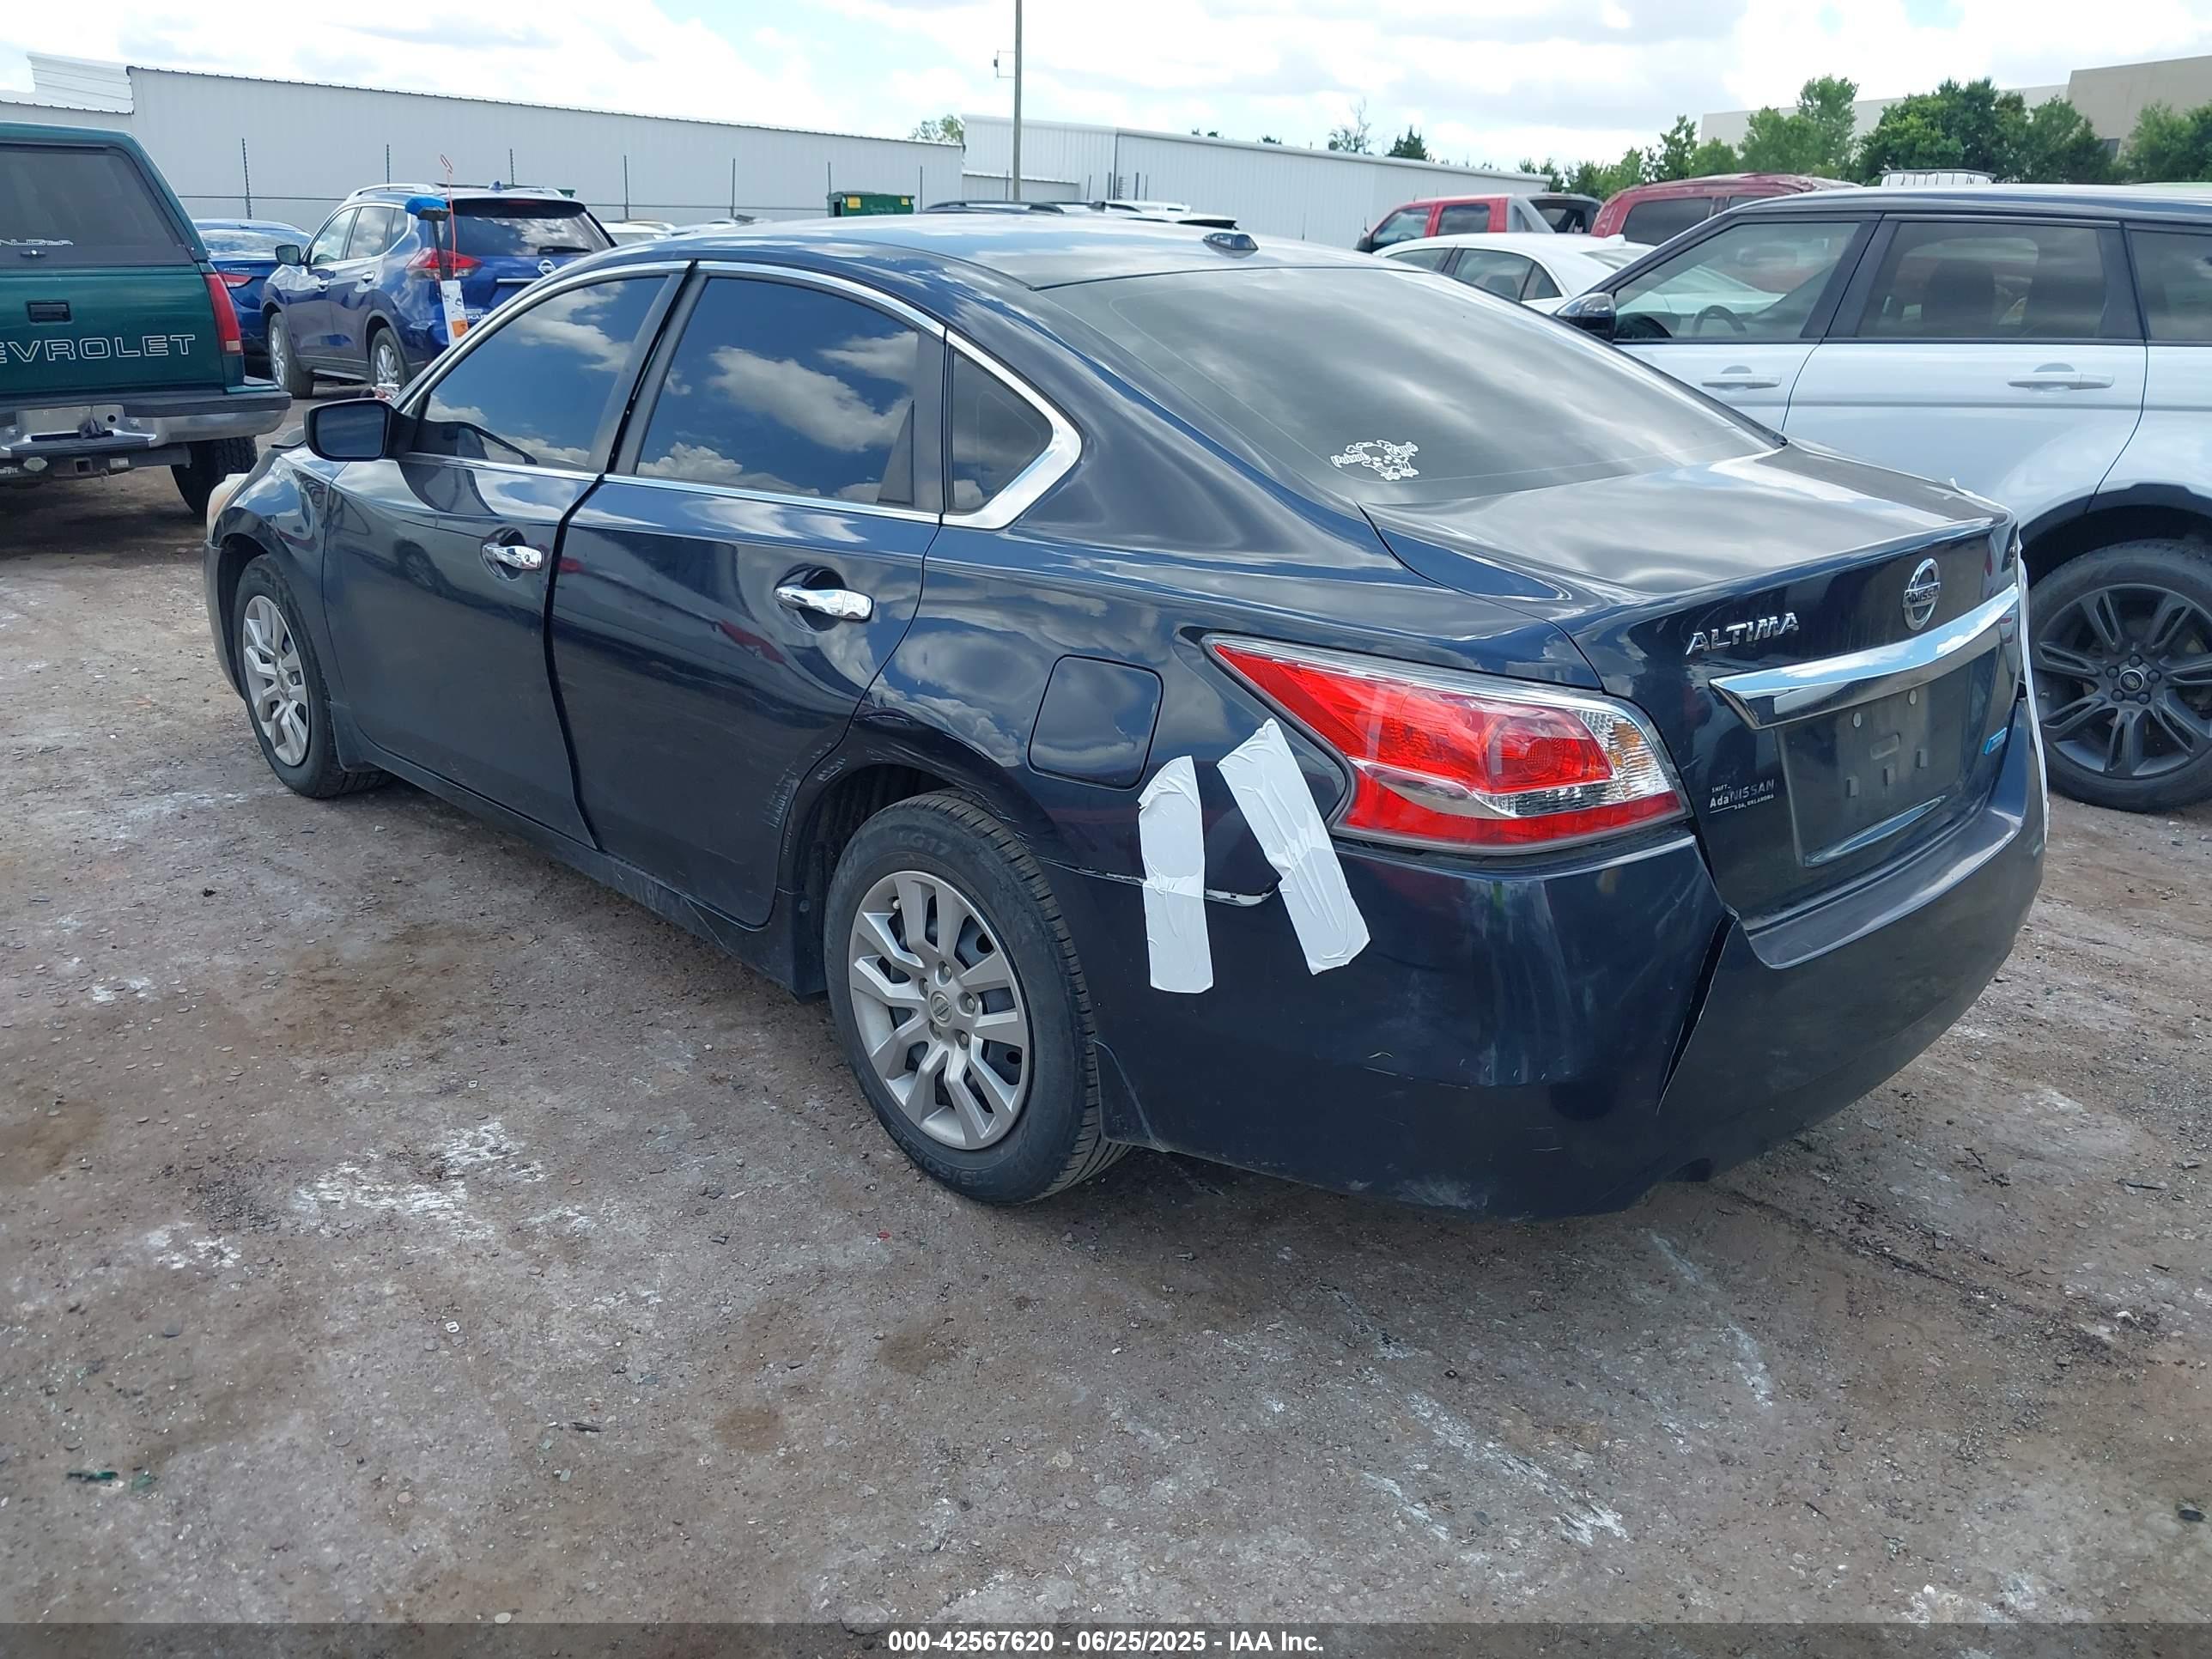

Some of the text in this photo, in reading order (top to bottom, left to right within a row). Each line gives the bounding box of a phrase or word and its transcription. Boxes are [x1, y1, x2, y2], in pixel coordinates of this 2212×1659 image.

[0, 334, 196, 364] VROLET
[1685, 612, 1799, 655] ALTIMA
[1729, 778, 1775, 803] NISSAN
